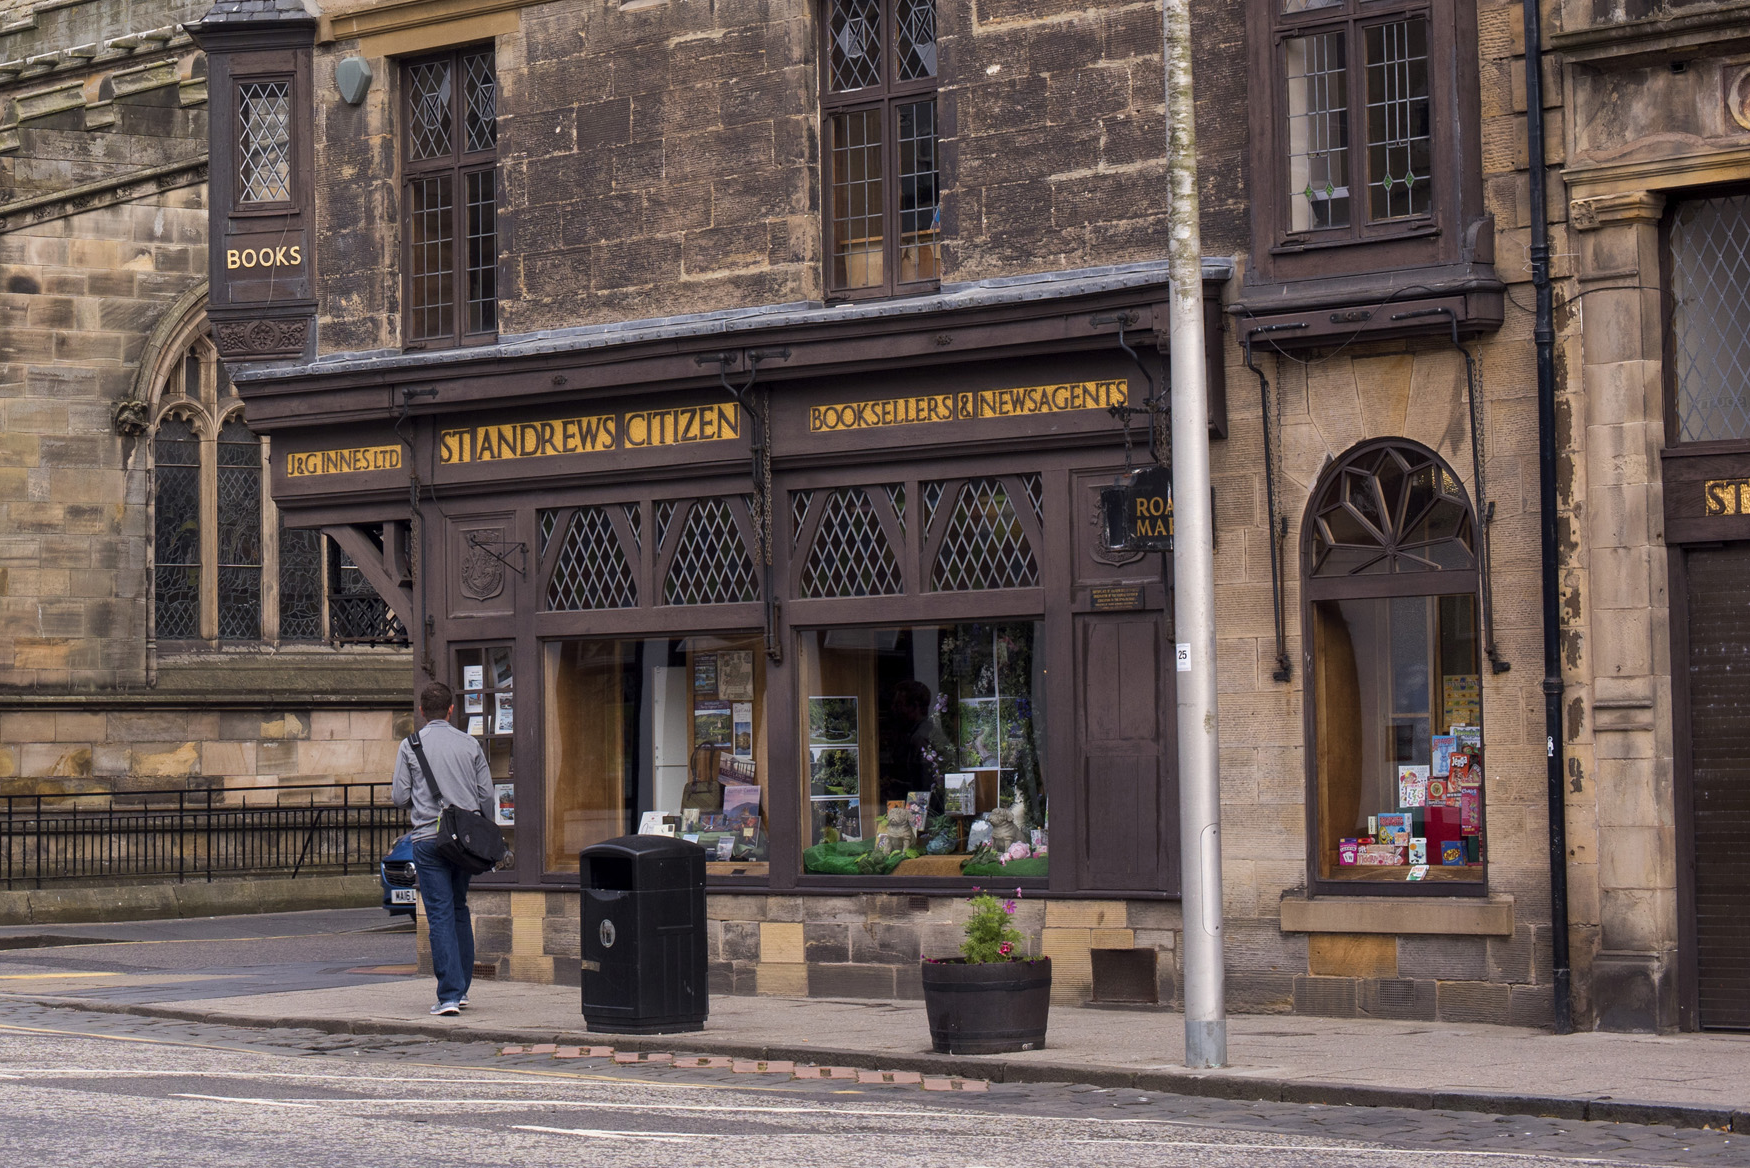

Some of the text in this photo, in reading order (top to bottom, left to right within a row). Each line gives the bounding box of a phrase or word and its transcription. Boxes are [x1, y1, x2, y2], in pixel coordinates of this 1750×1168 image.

[227, 246, 302, 269] BOOKS
[811, 381, 1128, 431] BOOKSELLERS & NEWSAGENTS
[440, 403, 739, 463] ST ANDREWS CITIZEN
[289, 448, 400, 475] J&G INNES LTD
[1136, 497, 1173, 517] ROA
[1709, 483, 1749, 514] ST
[1178, 650, 1187, 659] 25
[1452, 756, 1468, 768] Jenga
